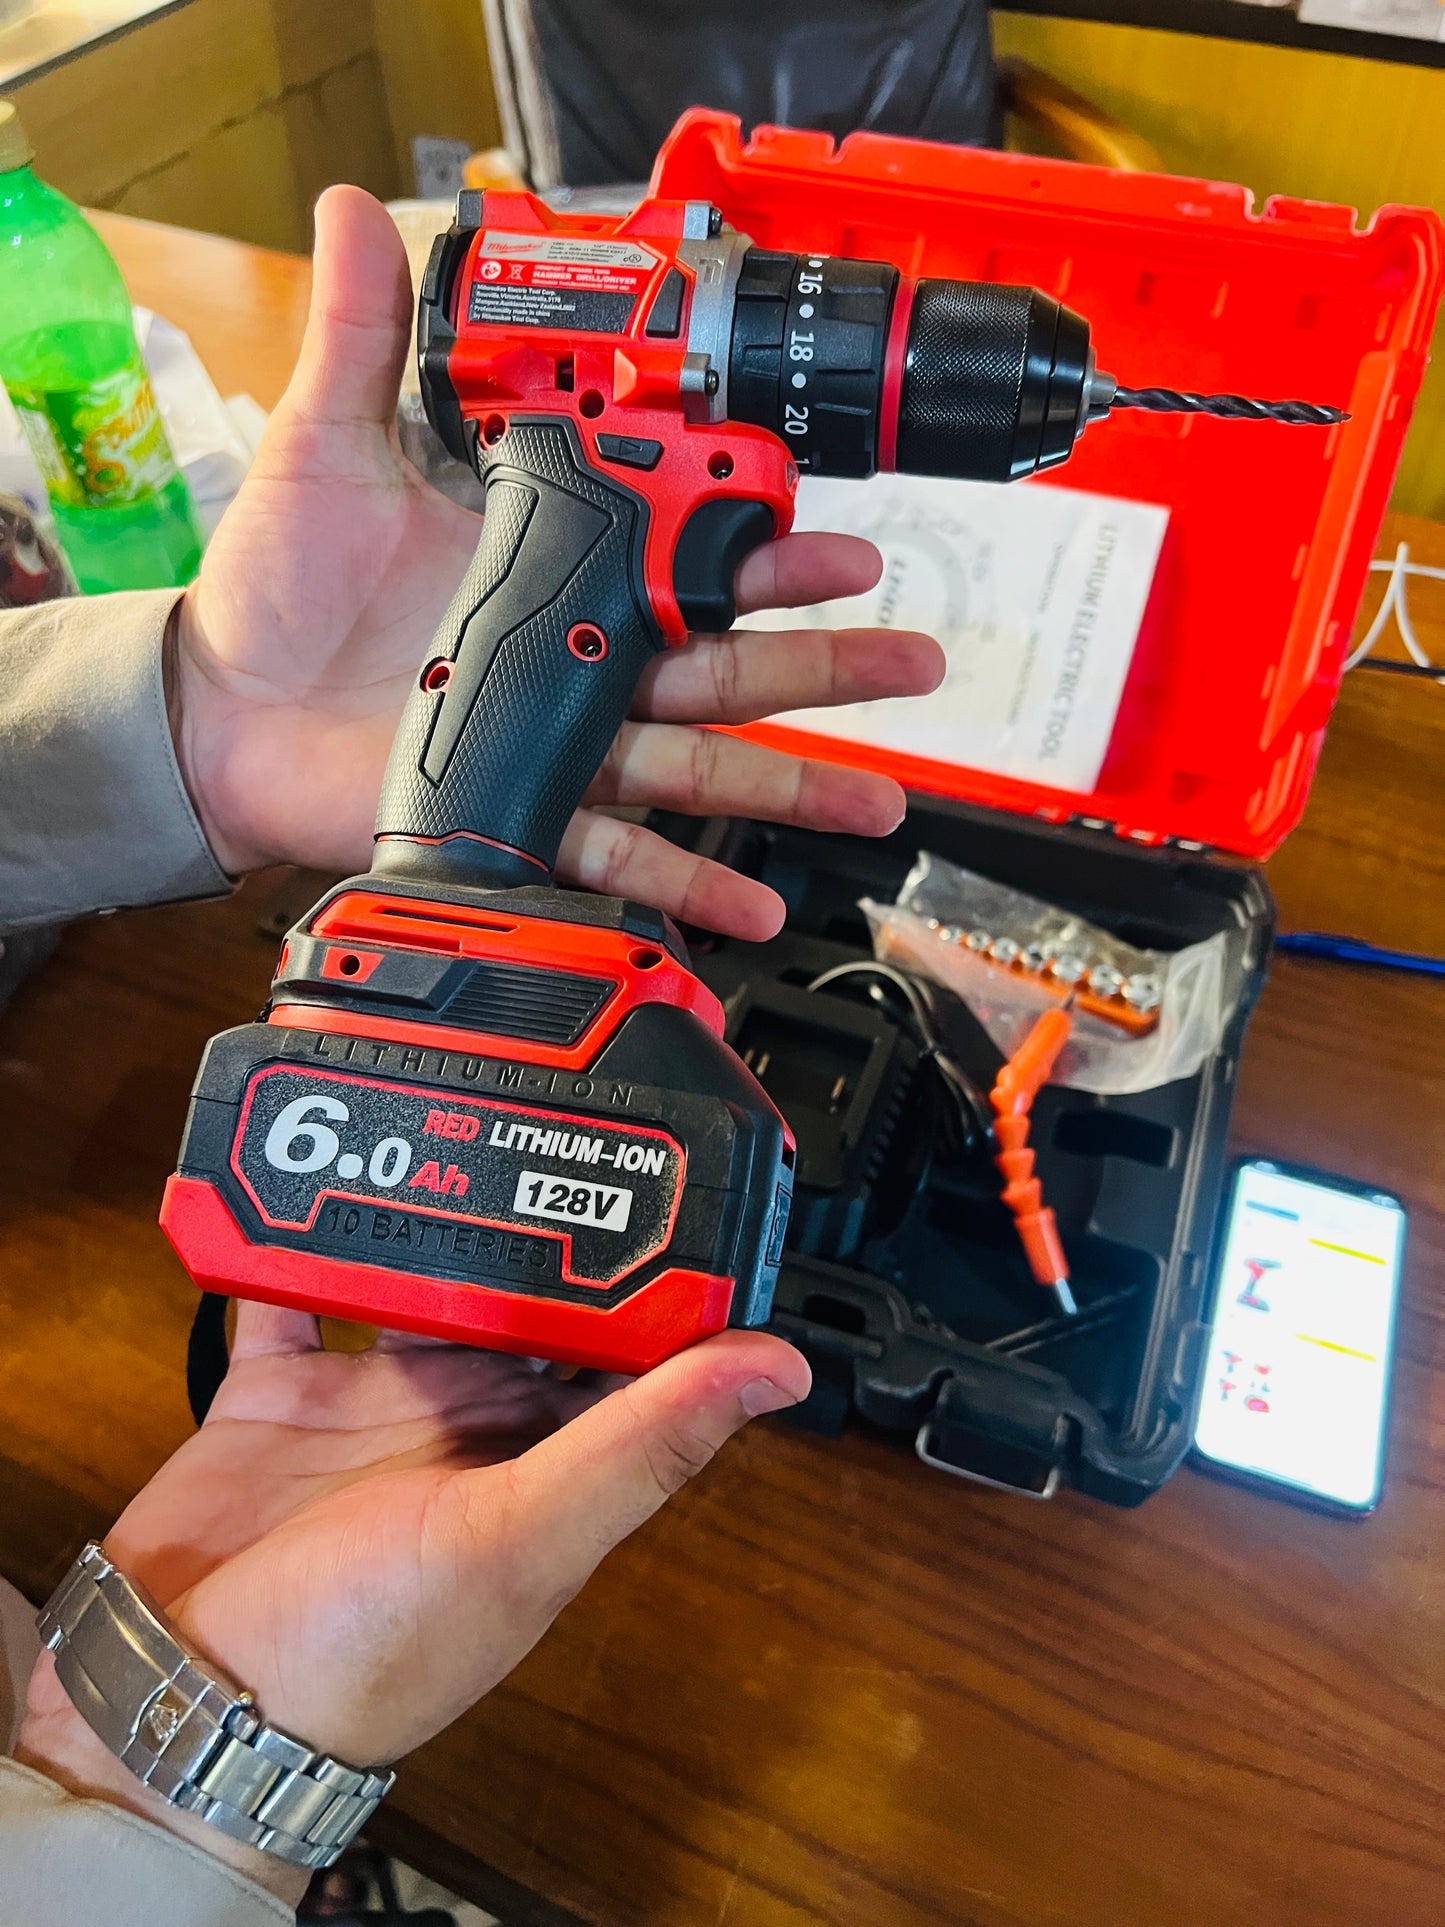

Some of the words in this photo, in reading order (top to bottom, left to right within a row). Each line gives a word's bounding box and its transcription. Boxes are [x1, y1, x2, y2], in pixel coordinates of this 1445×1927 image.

[476, 284, 507, 292] Milwaukee
[507, 286, 527, 294] Electric
[533, 271, 572, 280] HAMMER
[576, 273, 637, 285] DRILL/DRIVER
[797, 271, 823, 295] 16
[789, 330, 815, 362] 18
[784, 403, 809, 436] 20
[1053, 610, 1096, 702] ELECTRIC
[1037, 702, 1070, 760] TOOL
[313, 1034, 634, 1107] LITHIUM-ION
[264, 1094, 413, 1188] 6.0
[407, 1160, 471, 1197] Ah
[422, 1109, 481, 1142] RED
[488, 1120, 667, 1176] LITHIUM-ION
[527, 1180, 620, 1221] 128V
[327, 1205, 361, 1236] 10
[369, 1212, 550, 1270] BATTERIES
